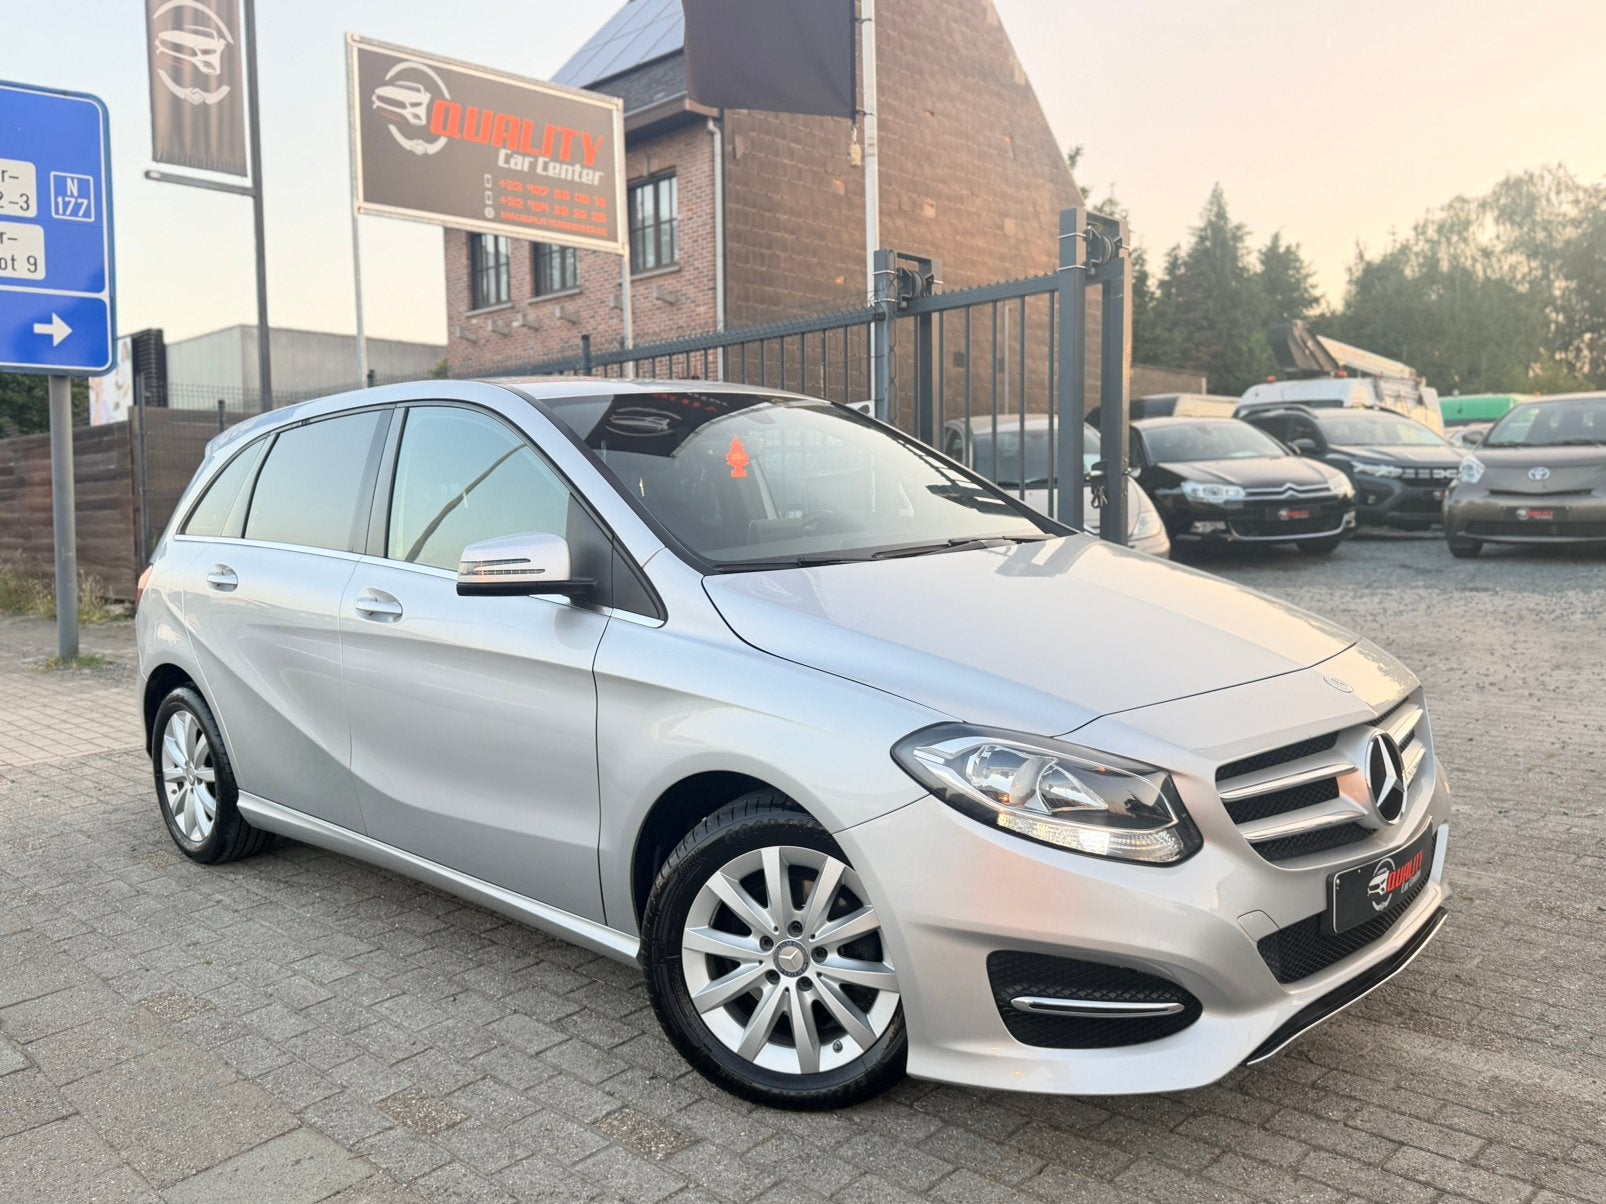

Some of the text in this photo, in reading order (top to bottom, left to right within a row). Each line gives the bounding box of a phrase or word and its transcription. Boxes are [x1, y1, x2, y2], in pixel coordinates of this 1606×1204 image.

[430, 99, 605, 167] QUALITY
[497, 148, 604, 186] Car Center
[66, 177, 78, 197] N
[57, 196, 88, 217] 177
[26, 255, 38, 273] 9
